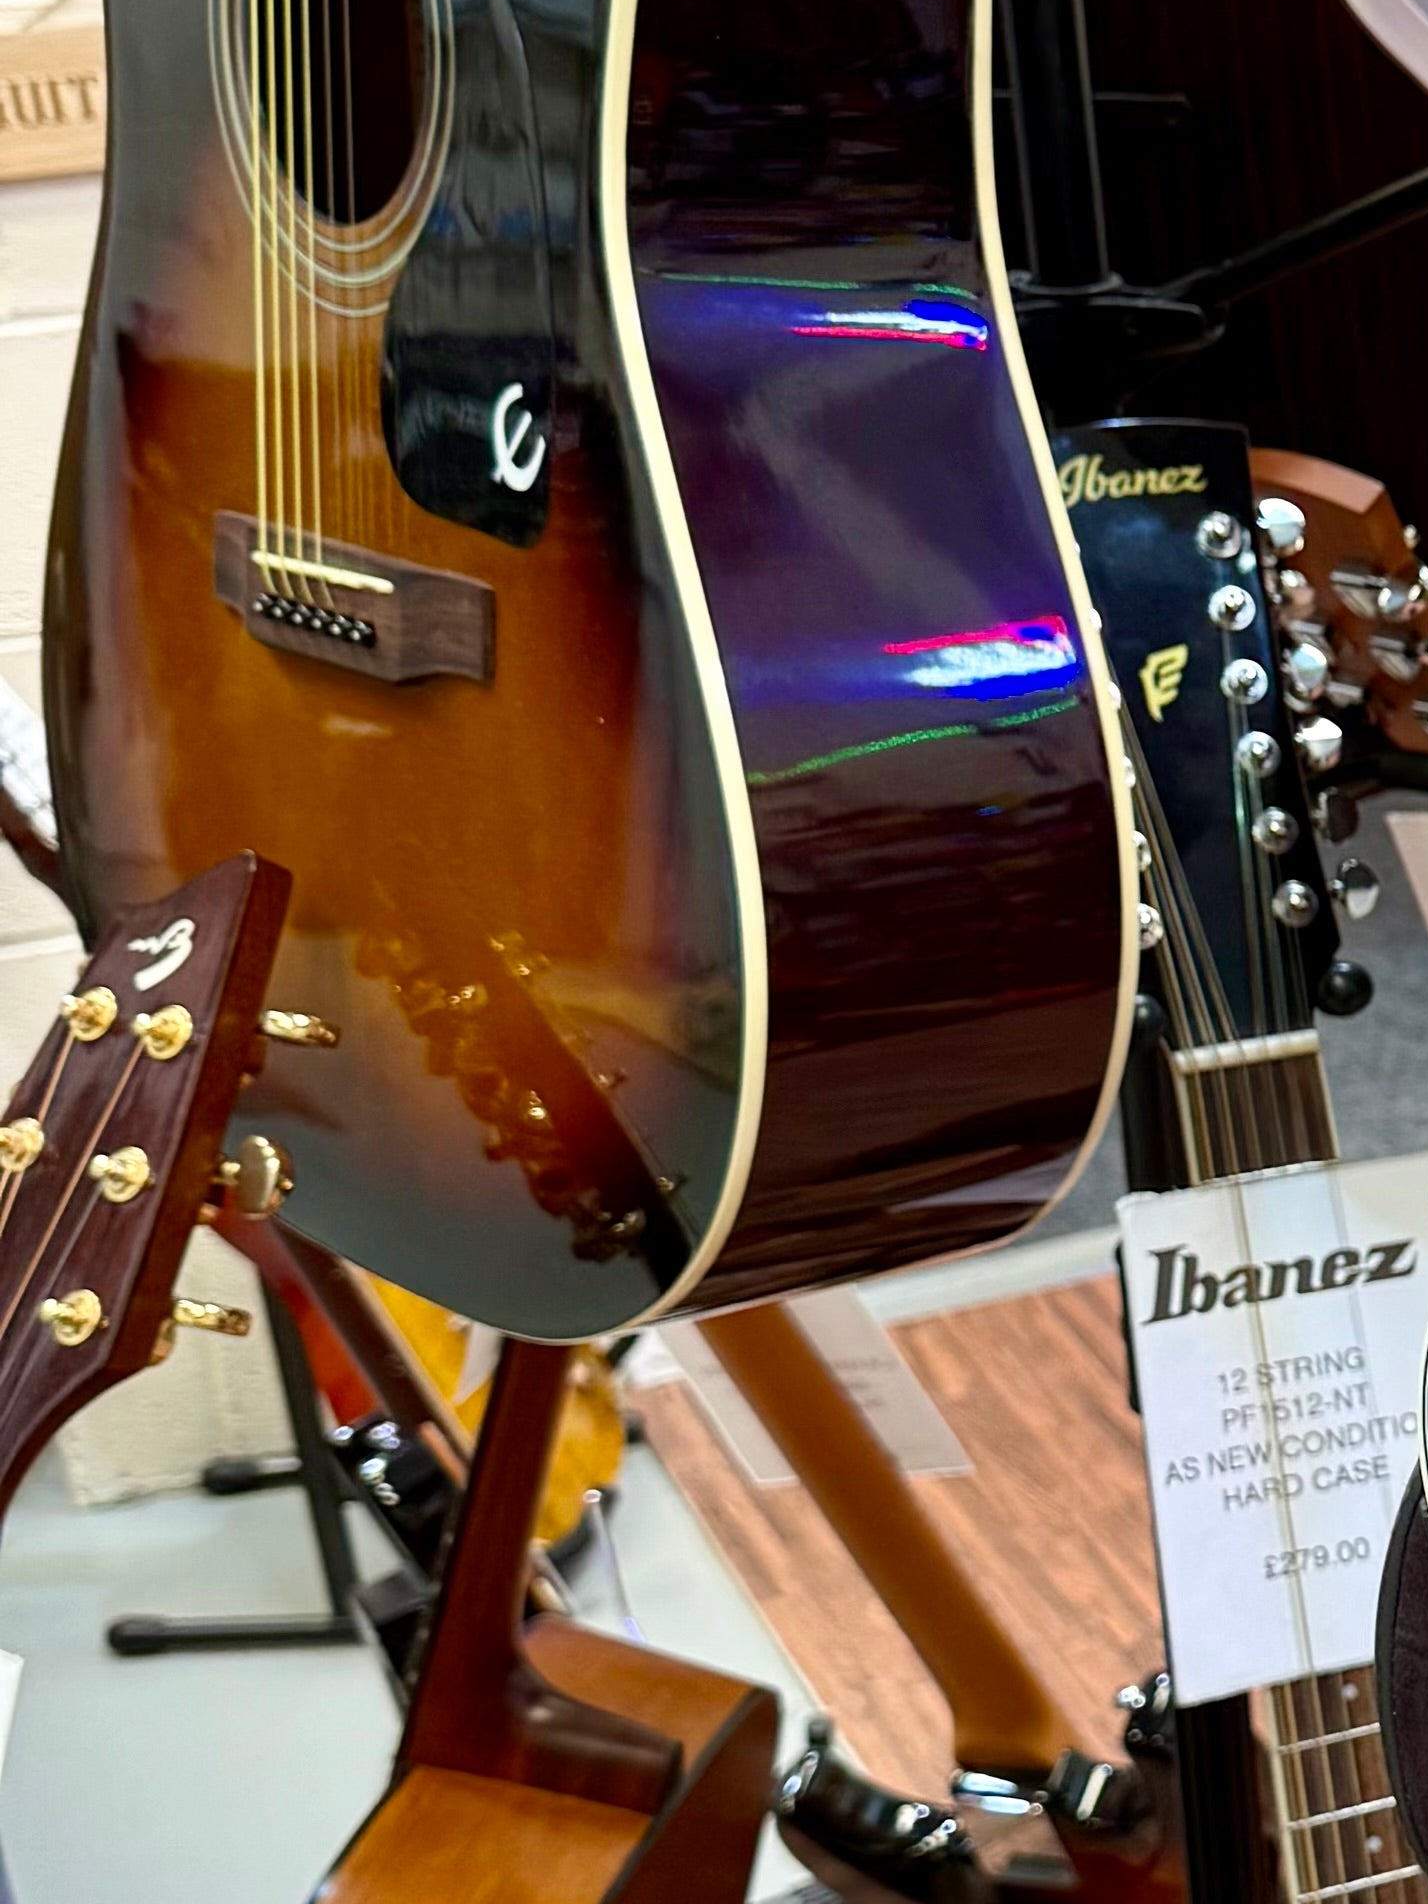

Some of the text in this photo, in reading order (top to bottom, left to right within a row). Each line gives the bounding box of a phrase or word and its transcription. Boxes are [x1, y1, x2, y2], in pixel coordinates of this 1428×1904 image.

[1058, 453, 1208, 509] Ibanez
[1142, 1238, 1417, 1326] Ibanez
[1218, 1346, 1365, 1395] 12 STRING
[1165, 1457, 1200, 1486] AS
[1207, 1440, 1272, 1477] NEW
[1223, 1455, 1390, 1512] HARD CASE
[1265, 1536, 1370, 1580] £279.00
